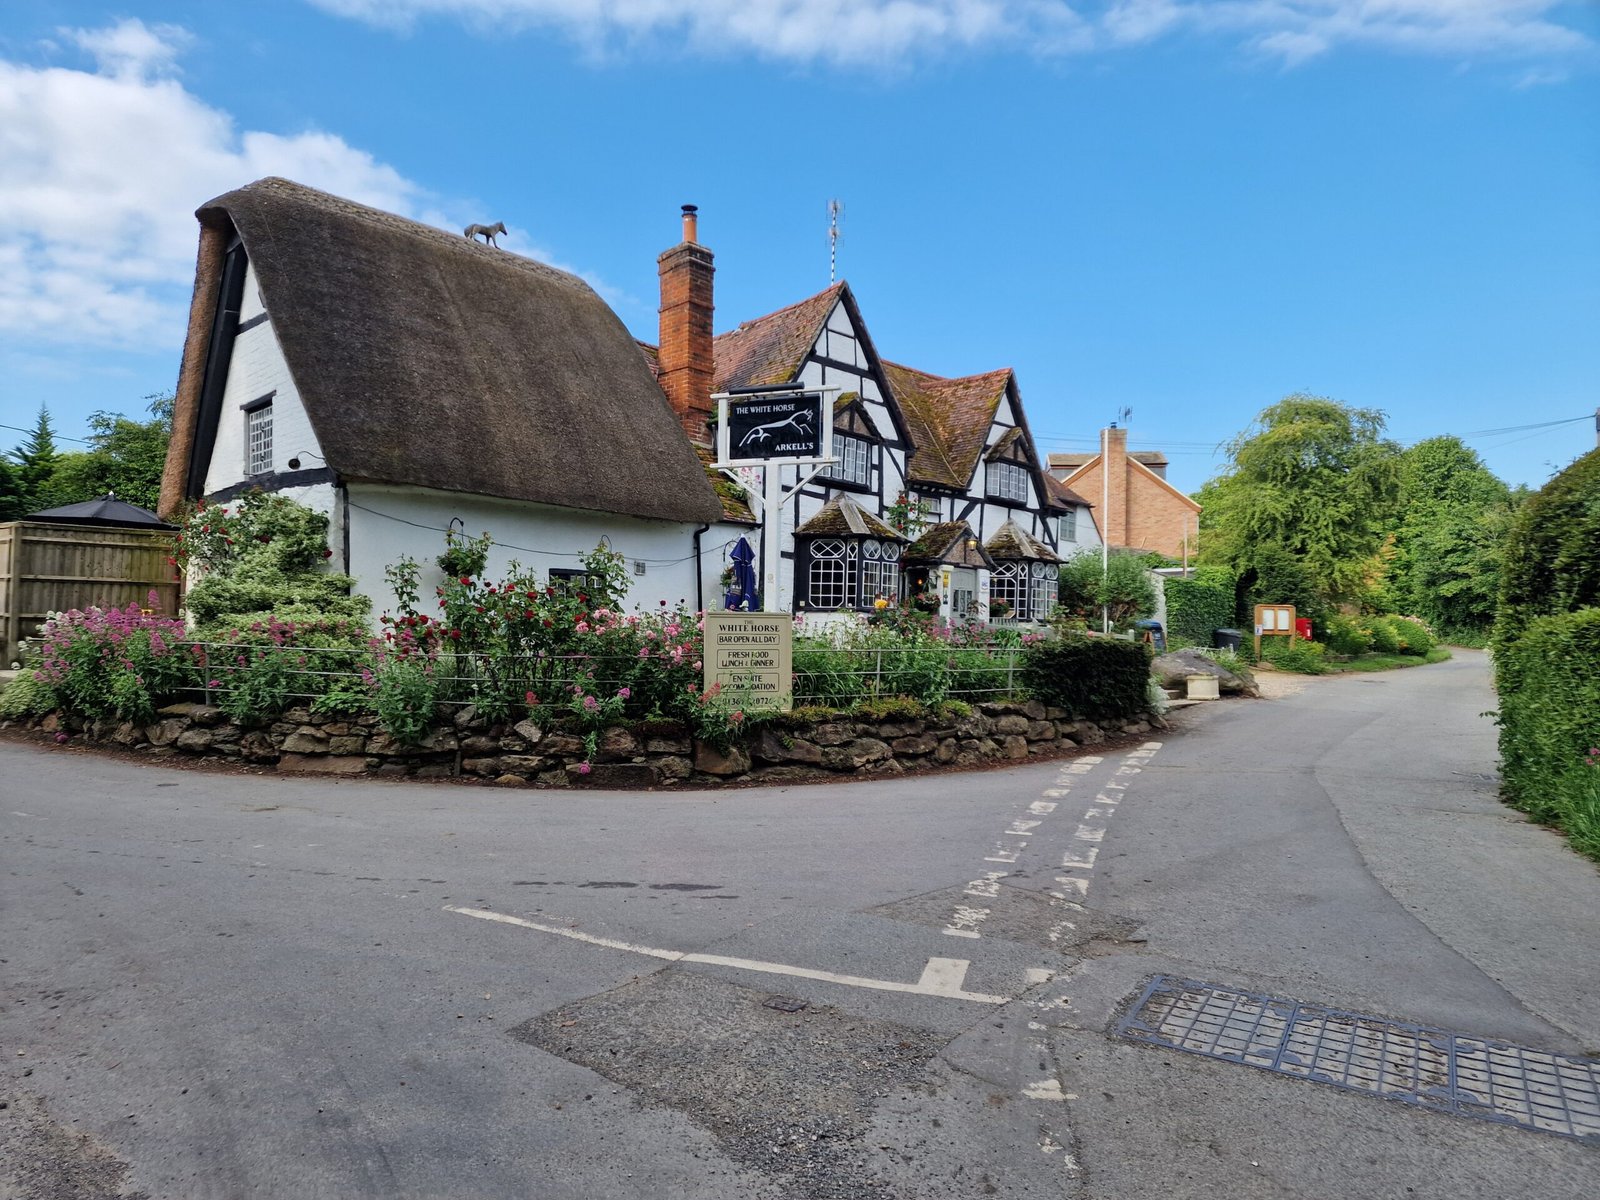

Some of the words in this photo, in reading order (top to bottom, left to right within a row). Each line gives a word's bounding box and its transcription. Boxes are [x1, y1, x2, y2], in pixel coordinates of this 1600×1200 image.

[736, 407, 749, 415] THE
[750, 405, 771, 413] WHITE
[772, 404, 795, 412] HORSE
[775, 442, 814, 451] ARKELL'S
[719, 624, 749, 632] WHITE
[751, 624, 780, 632] HORSE
[728, 651, 750, 659] FRESH
